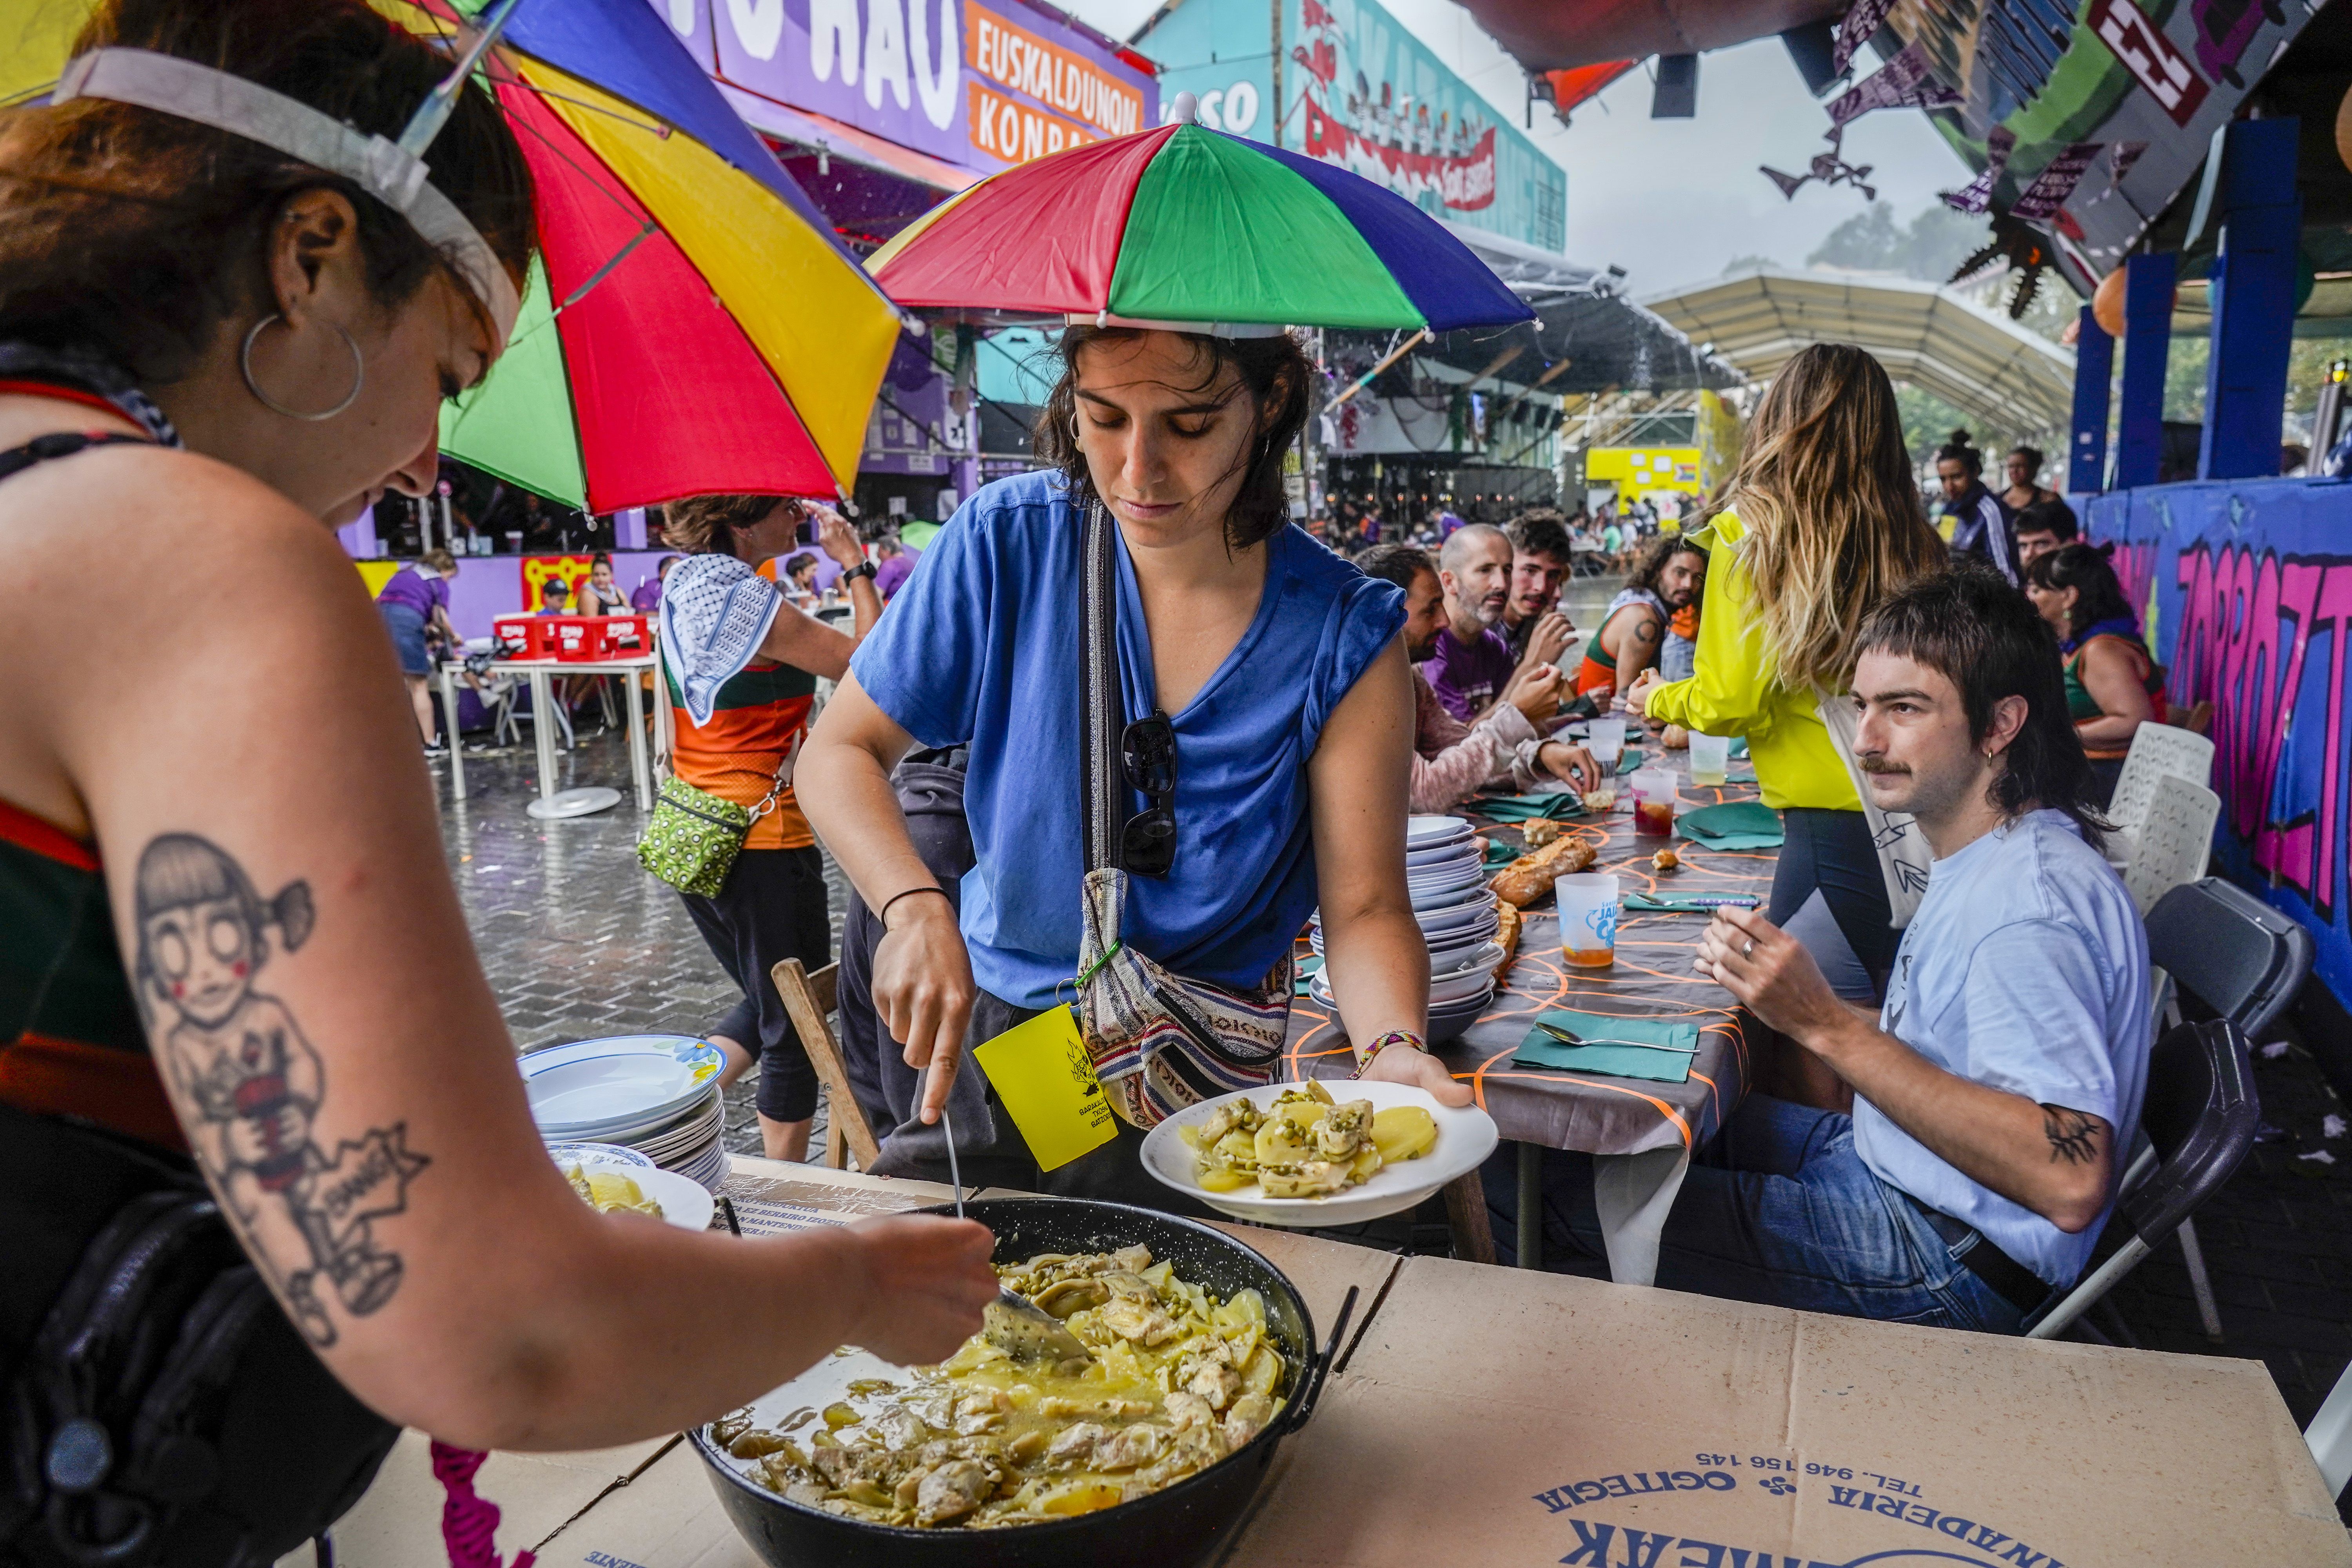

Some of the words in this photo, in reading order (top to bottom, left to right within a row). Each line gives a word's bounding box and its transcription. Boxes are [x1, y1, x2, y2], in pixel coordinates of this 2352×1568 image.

[977, 18, 1138, 136] EUSKALDUNON
[757, 1210, 807, 1221] BERRIRO
[1695, 1453, 1742, 1466] 145
[1750, 1456, 1797, 1472] 156
[1806, 1463, 1853, 1480] 946
[1532, 1470, 1737, 1514] OGITEGIA
[1862, 1472, 1923, 1498] TEL.
